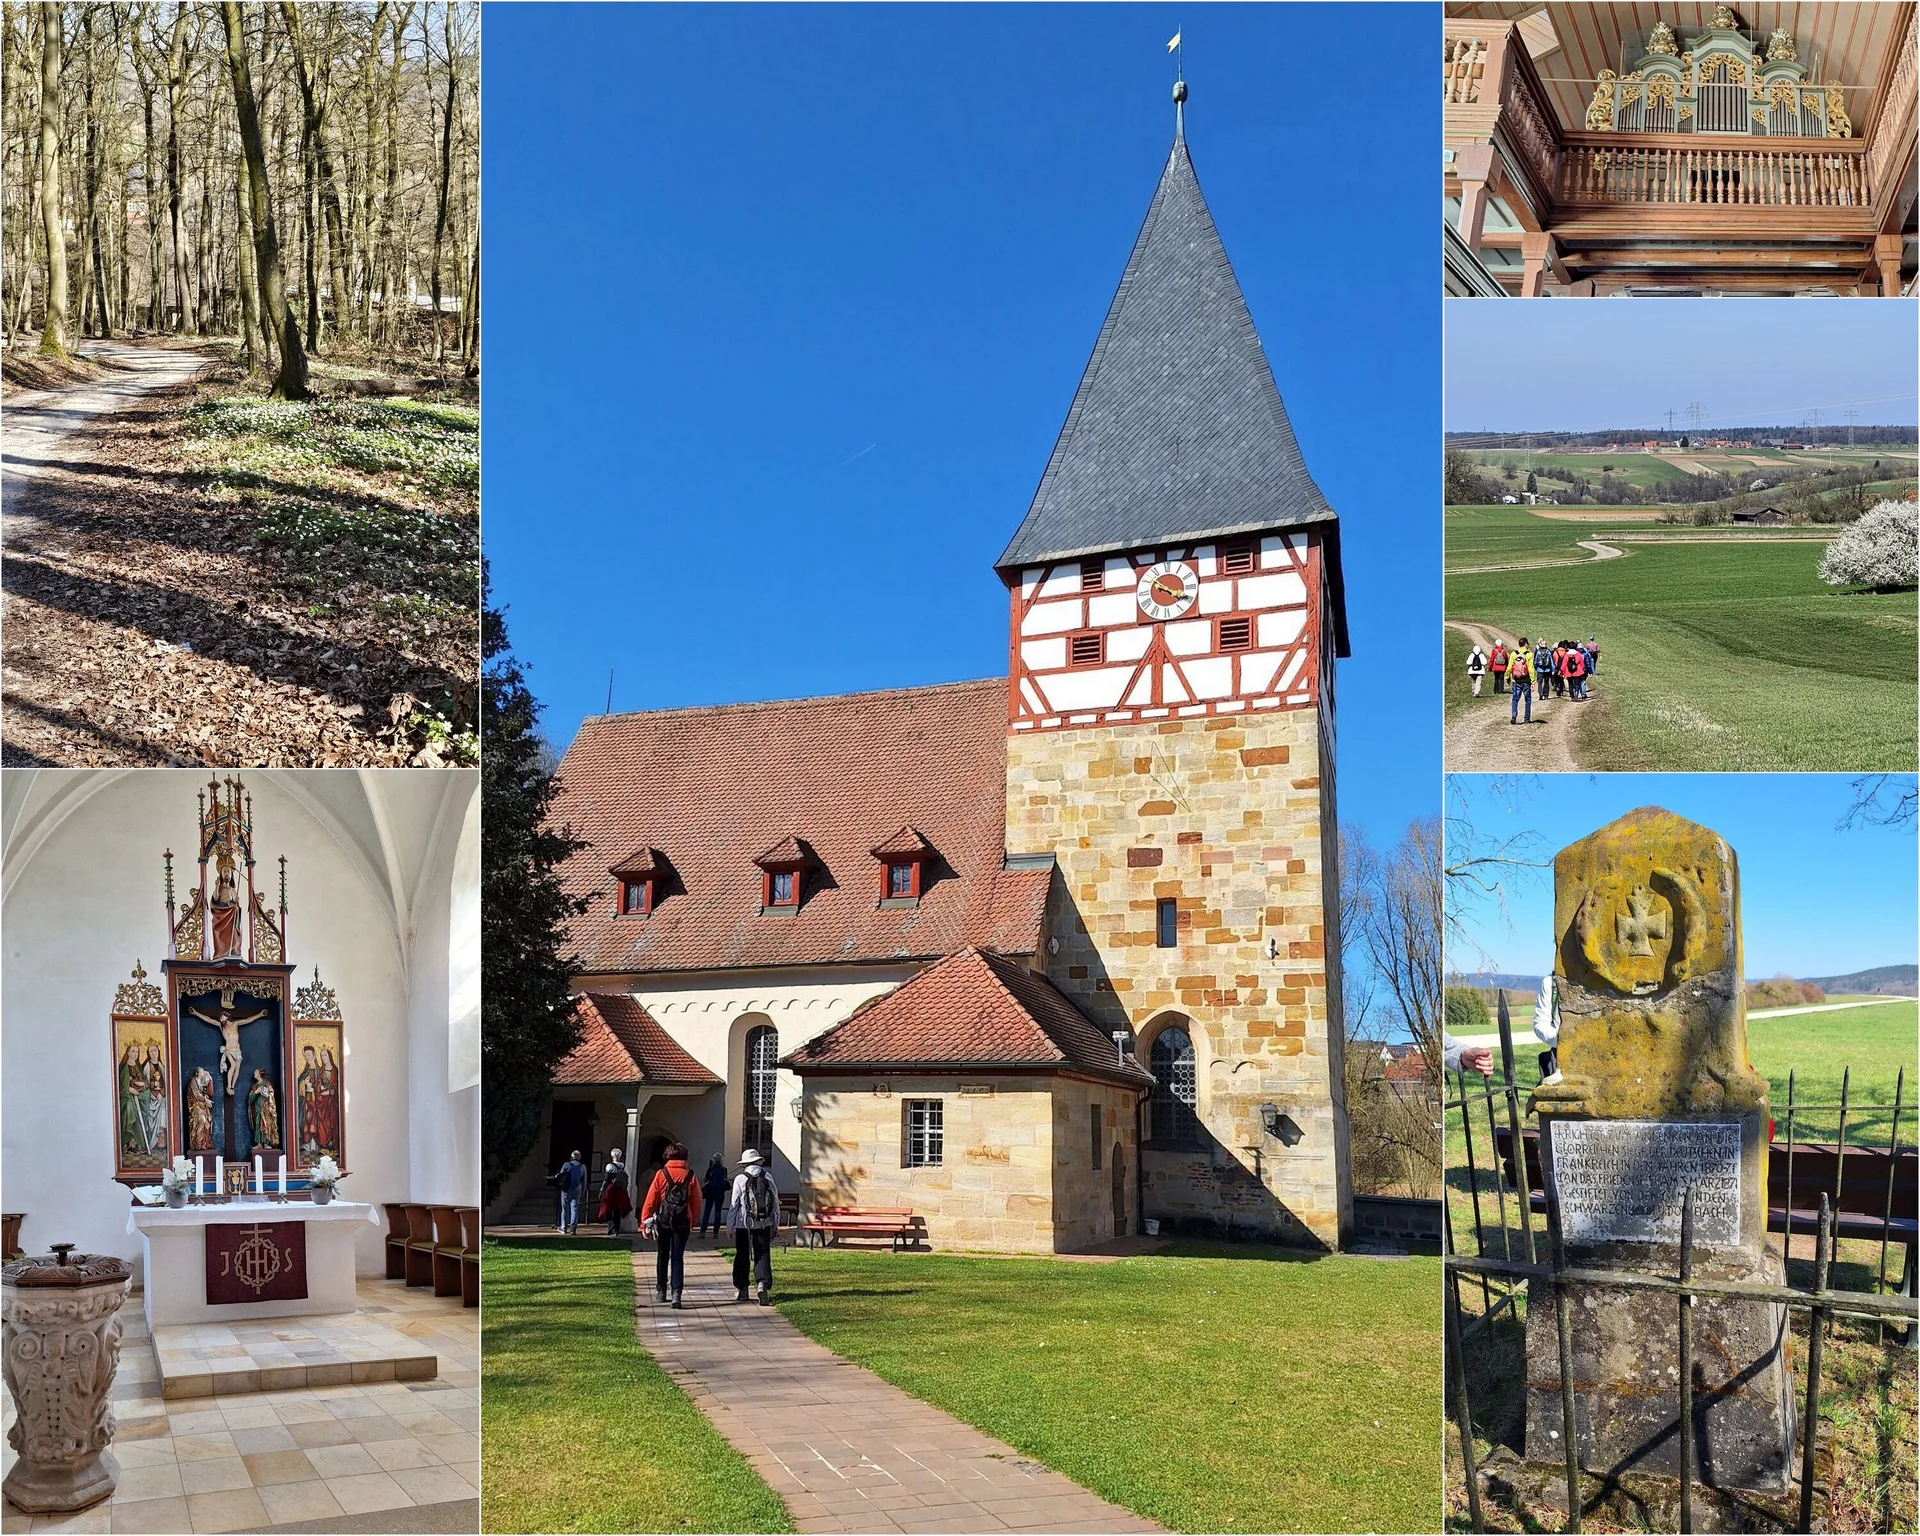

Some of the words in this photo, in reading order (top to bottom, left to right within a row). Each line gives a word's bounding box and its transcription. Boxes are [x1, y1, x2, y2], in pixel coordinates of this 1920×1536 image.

[1635, 1130, 1692, 1143] ANDENKEN
[1695, 1132, 1713, 1145] AN
[1716, 1131, 1733, 1145] DIE
[1555, 1142, 1620, 1157] GLORREICHEN
[1669, 1145, 1723, 1160] DEUTSCHEN
[1724, 1146, 1735, 1160] IN
[1556, 1157, 1618, 1171] FRANKREICH
[1620, 1159, 1631, 1172] IN
[1633, 1160, 1653, 1172] DEN
[1564, 1186, 1608, 1200] GESTIFTET
[1611, 1188, 1633, 1201] VON
[1660, 1190, 1727, 1204] GMINDEN
